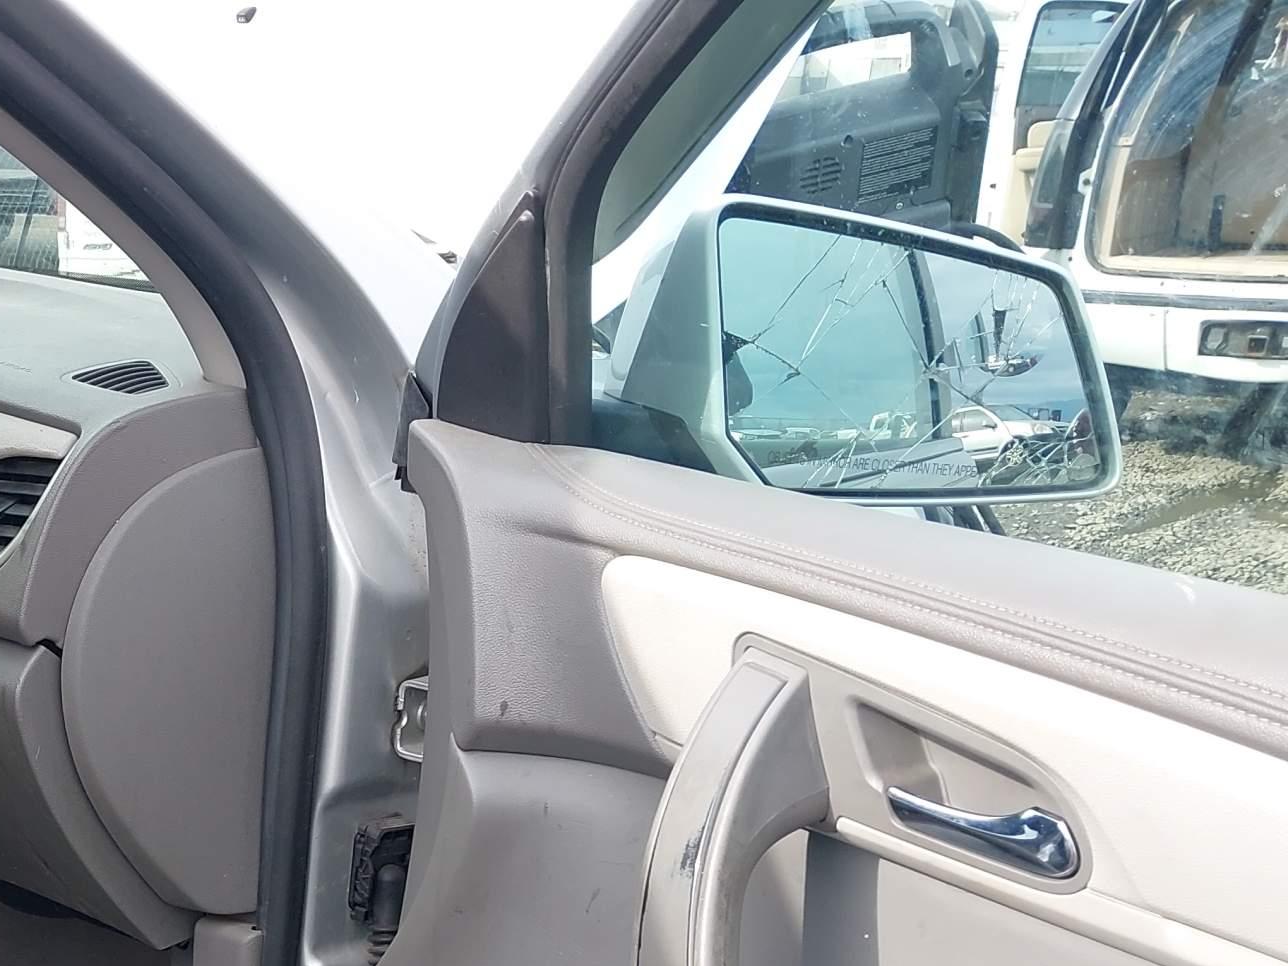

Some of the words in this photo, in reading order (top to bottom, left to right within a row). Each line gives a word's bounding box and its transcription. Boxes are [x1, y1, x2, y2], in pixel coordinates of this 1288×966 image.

[852, 457, 870, 471] ARE
[871, 458, 904, 473] CLOSER
[906, 460, 930, 475] THAN
[931, 462, 954, 477] THEY
